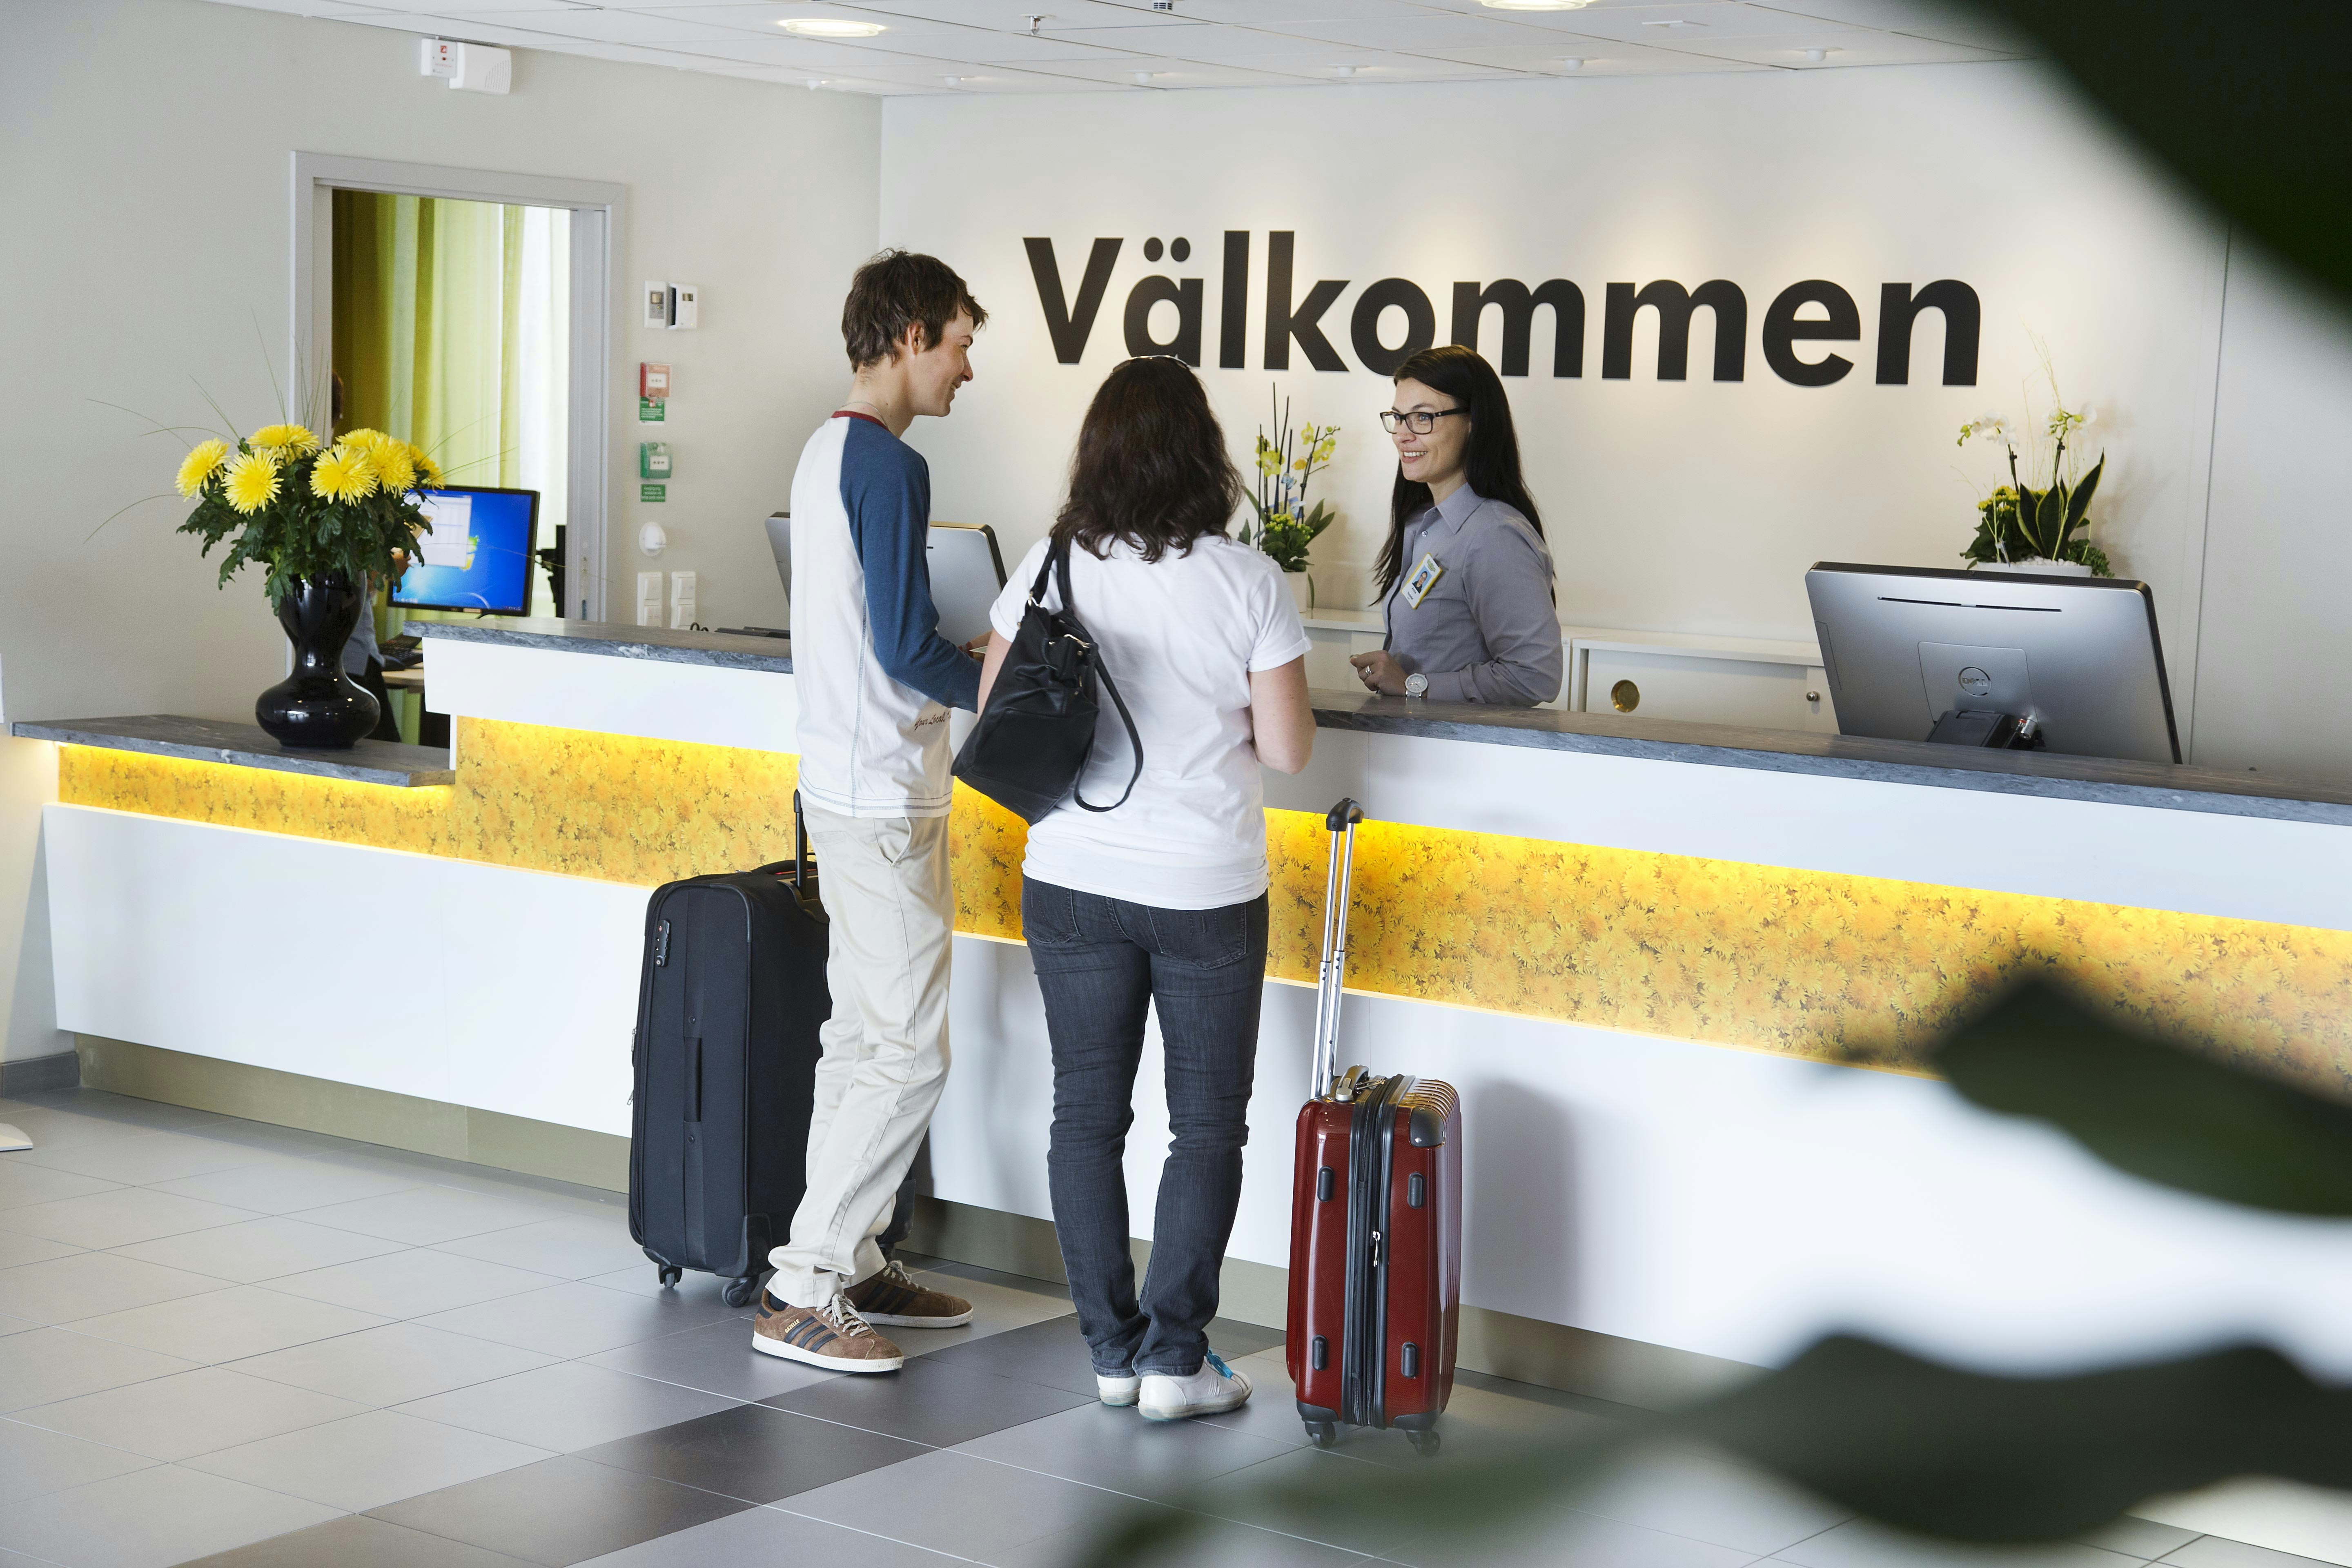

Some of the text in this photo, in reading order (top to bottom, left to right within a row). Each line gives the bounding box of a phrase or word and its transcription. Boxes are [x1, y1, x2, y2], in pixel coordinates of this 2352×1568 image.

[1022, 230, 1981, 387] Välkommen
[1962, 678, 1988, 686] DELL
[784, 1319, 800, 1333] GAZELLE
